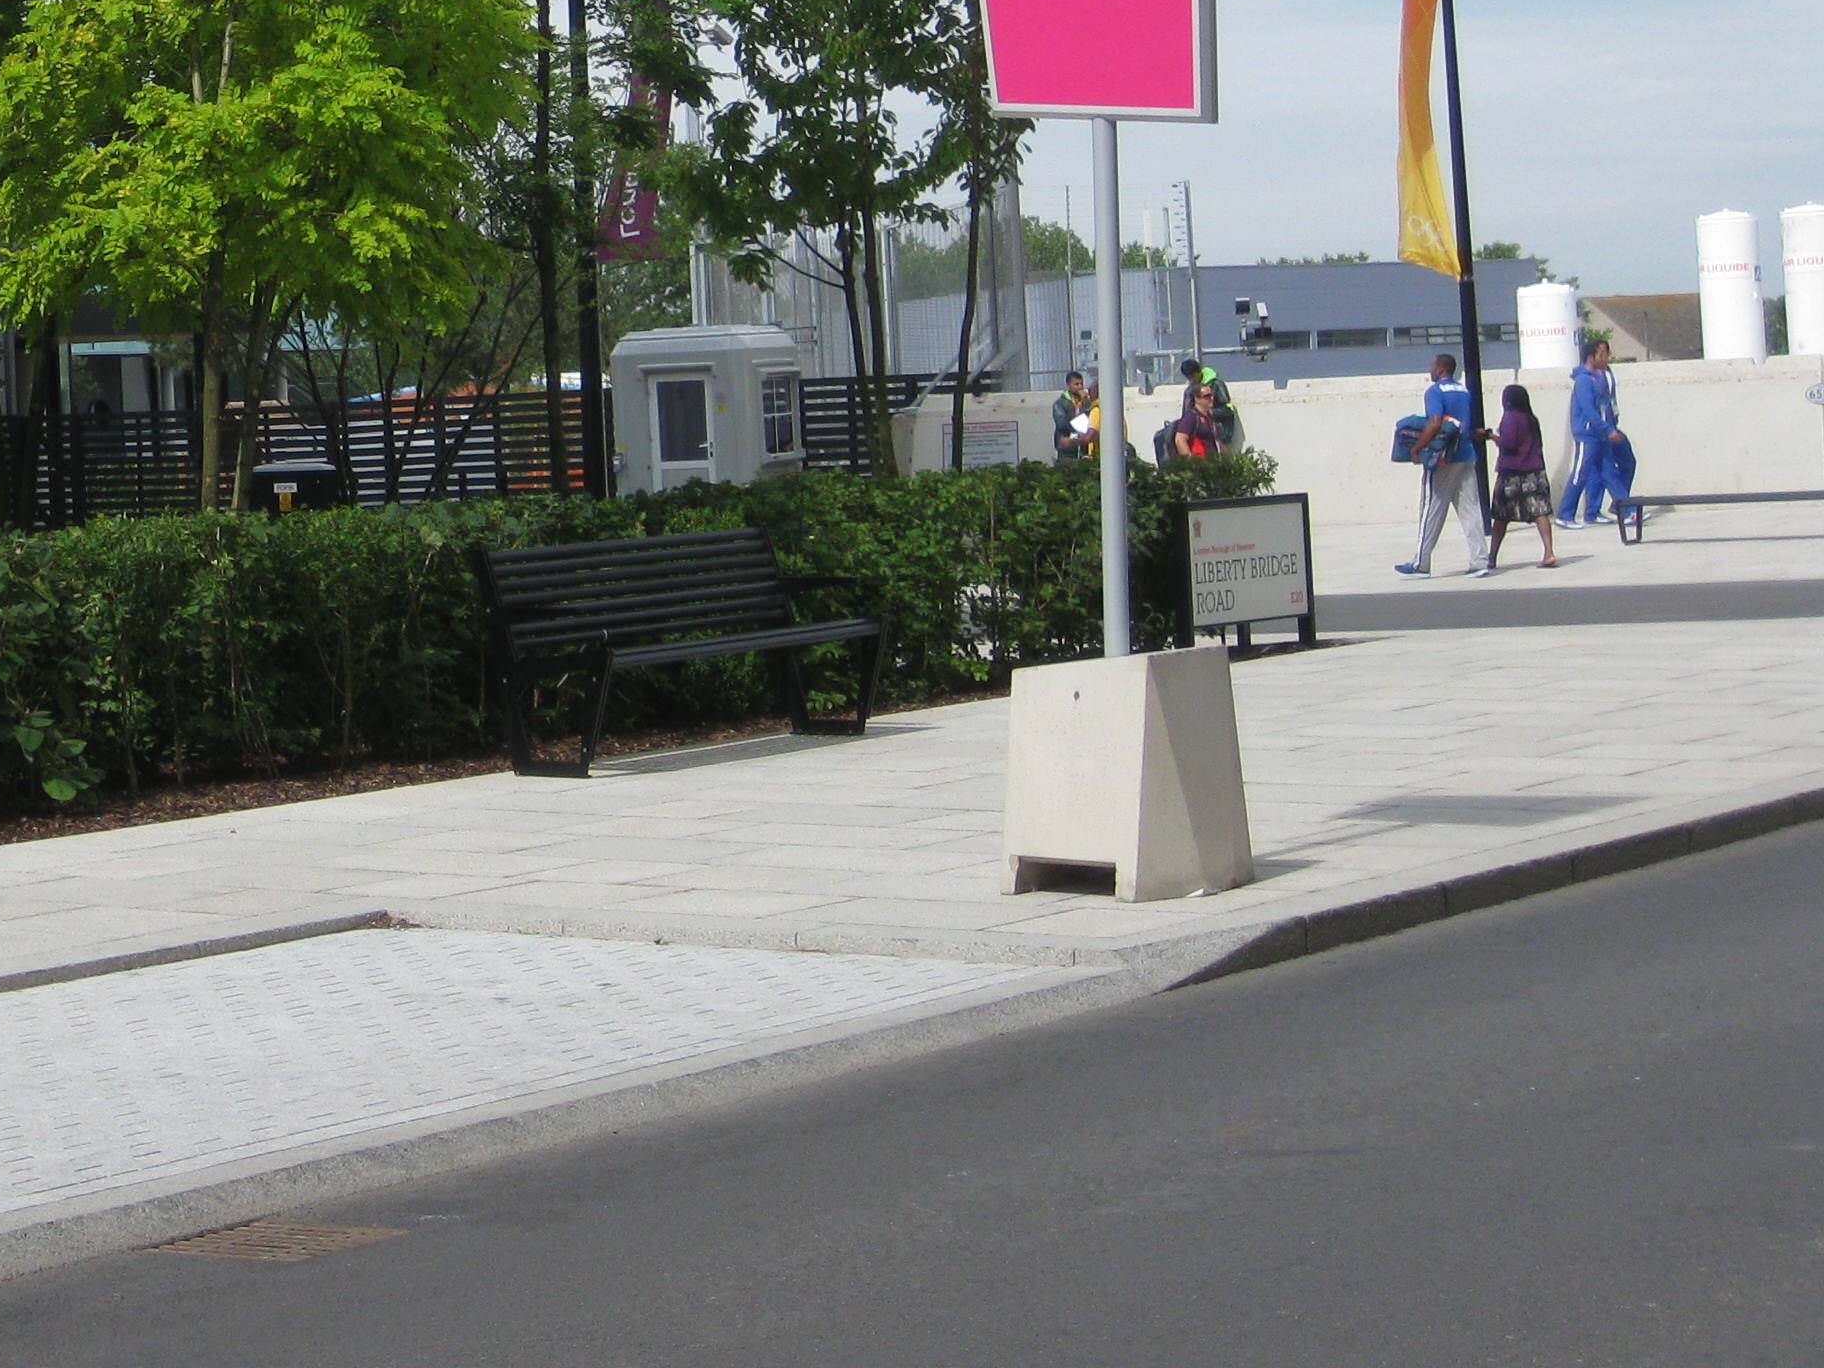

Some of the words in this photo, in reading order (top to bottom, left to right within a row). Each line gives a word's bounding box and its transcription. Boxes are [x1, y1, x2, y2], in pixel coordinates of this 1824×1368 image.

[1194, 558, 1246, 585] LIBERTY
[1250, 552, 1298, 579] BRIDGE
[1196, 589, 1235, 615] ROAD
